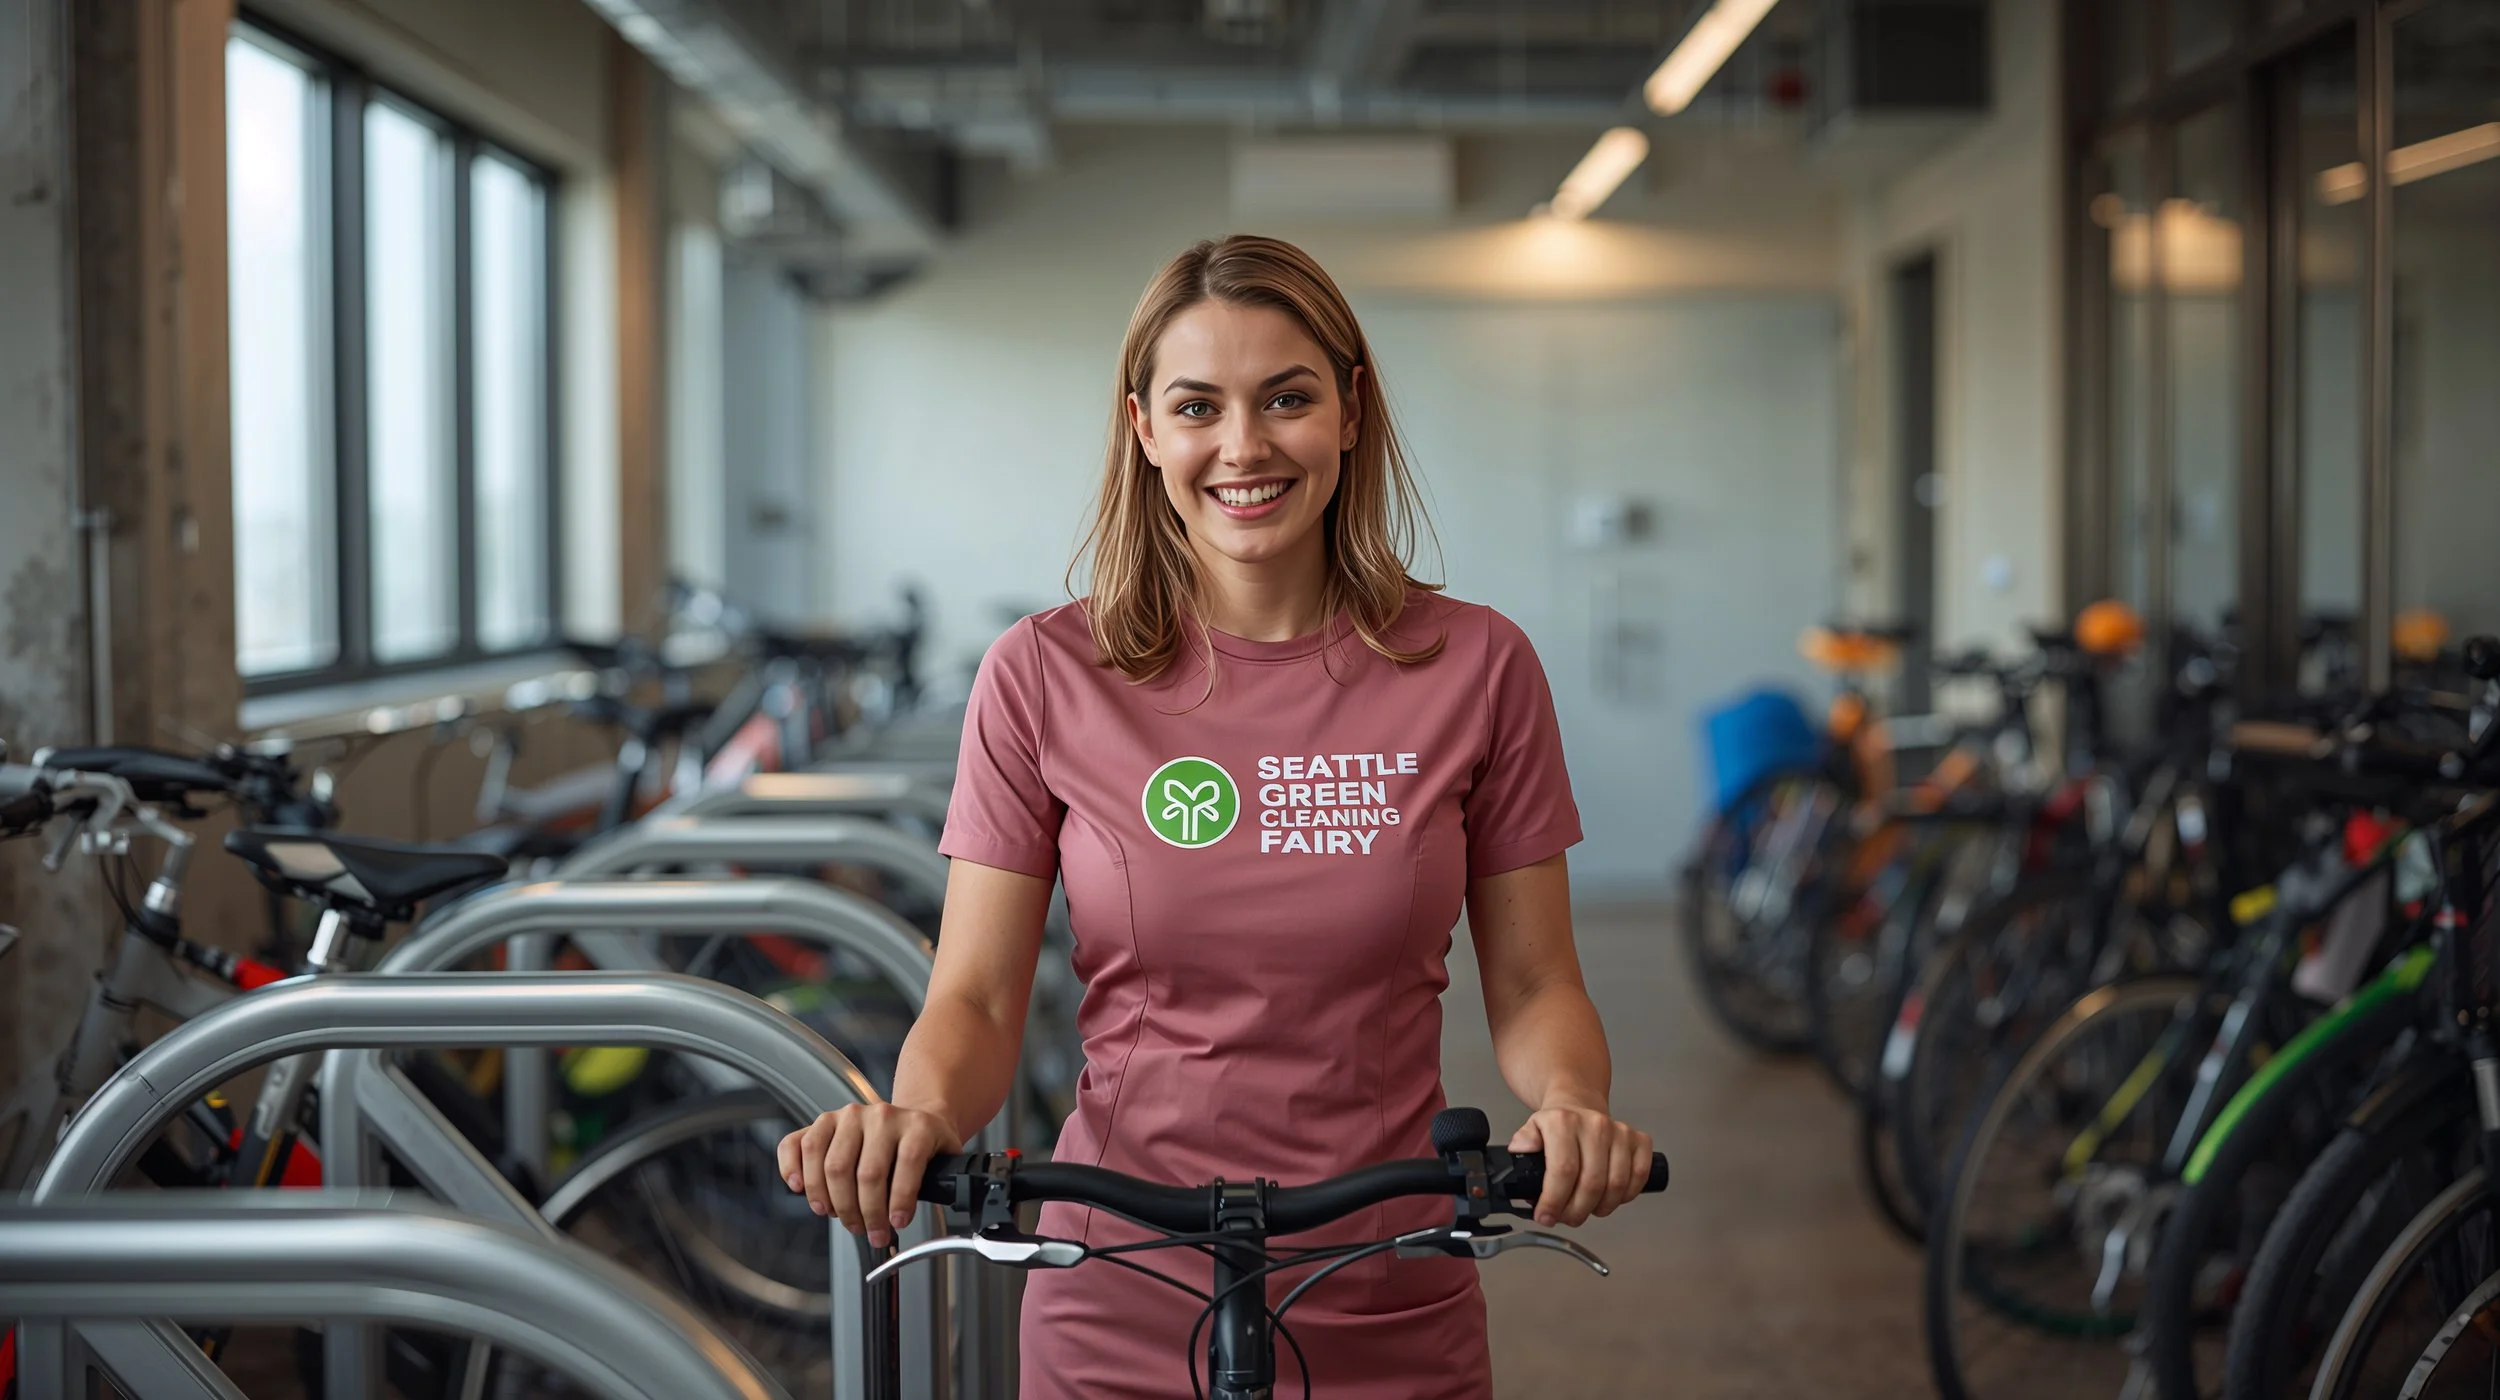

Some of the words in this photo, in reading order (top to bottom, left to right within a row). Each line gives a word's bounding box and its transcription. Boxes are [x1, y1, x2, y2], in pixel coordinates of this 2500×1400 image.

[1257, 752, 1419, 780] SEATTLE
[1258, 780, 1387, 807] GREEN
[1259, 807, 1400, 828] CLEANING
[1260, 829, 1379, 855] FAIRY
